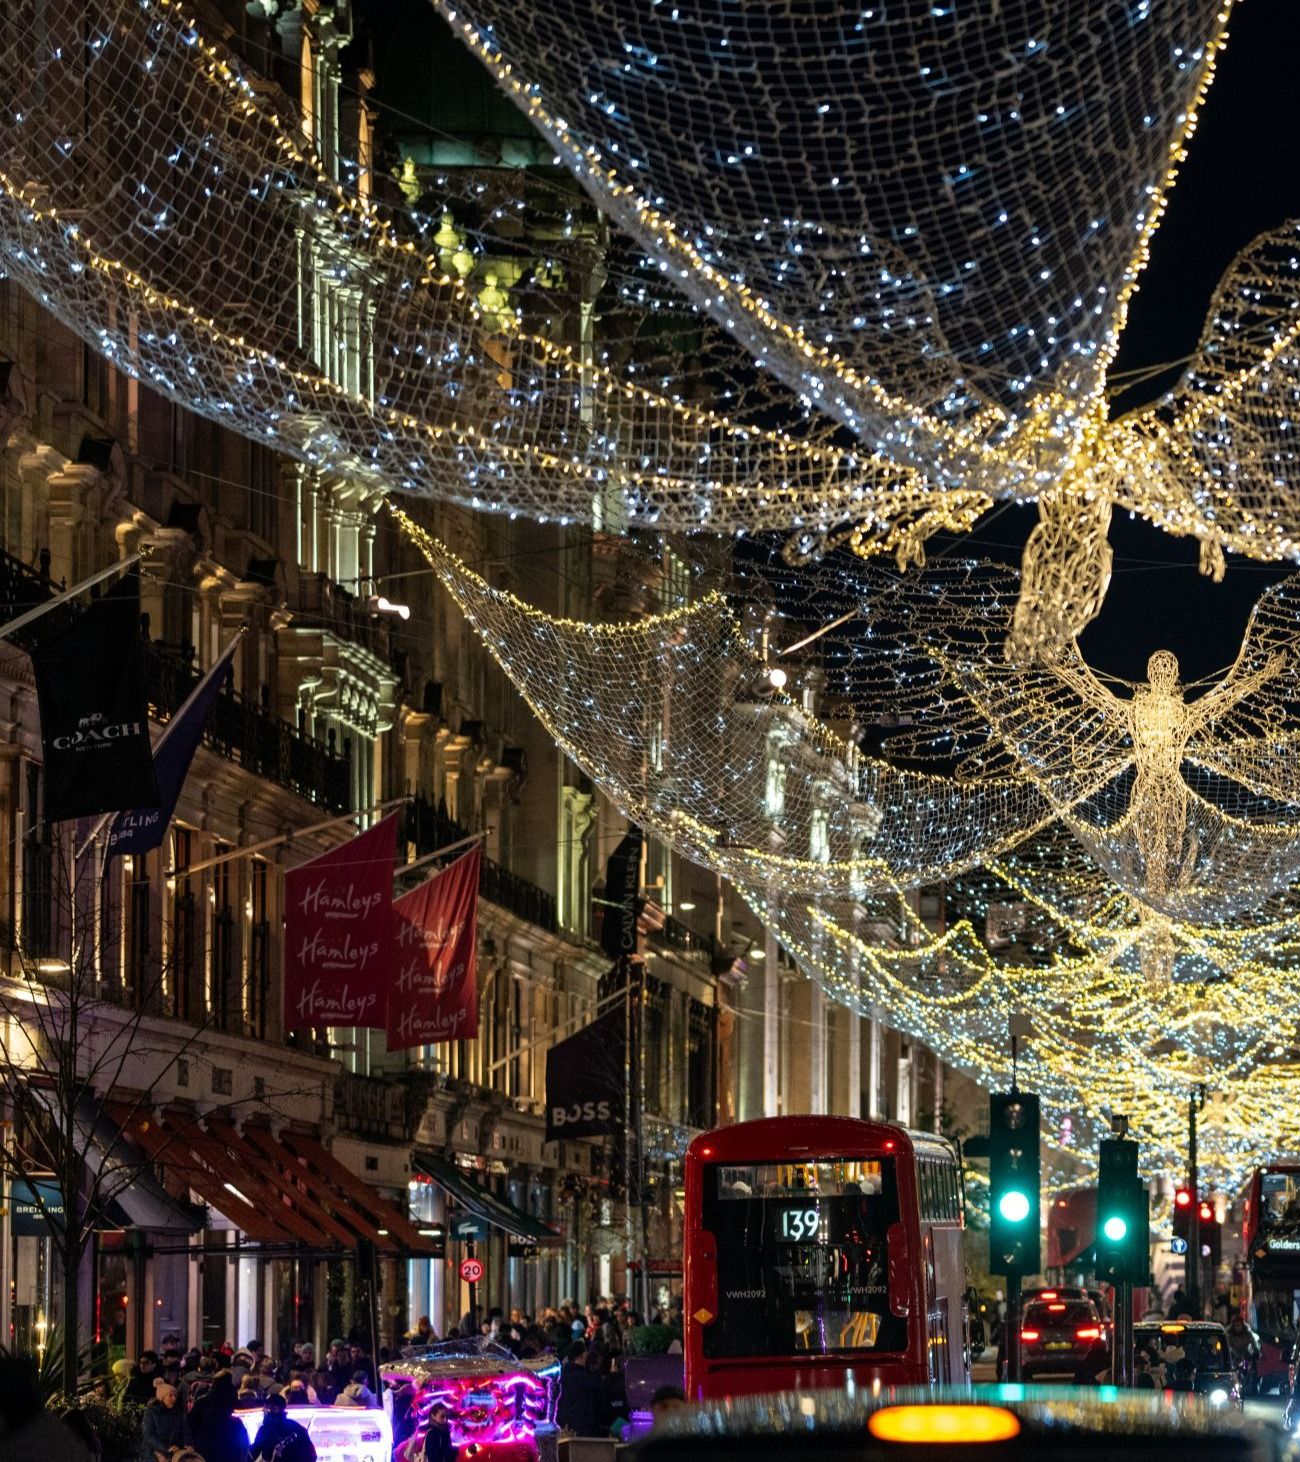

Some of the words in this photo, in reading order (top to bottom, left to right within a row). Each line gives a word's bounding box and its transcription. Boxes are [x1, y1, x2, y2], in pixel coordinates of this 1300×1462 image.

[53, 723, 141, 750] COACH
[625, 846, 640, 889] KLEIN
[298, 878, 381, 919] Hamleys
[396, 917, 466, 949] Hamleys
[620, 892, 635, 949] CALVIN
[296, 928, 379, 970] Hamleys
[395, 957, 465, 993] Hamleys
[295, 978, 377, 1021] Hamleys
[398, 1003, 467, 1039] Hamleys
[552, 1100, 610, 1126] BOSS
[782, 1210, 819, 1241] 139
[1269, 1240, 1300, 1249] Golders
[464, 1265, 481, 1276] 20
[726, 1289, 767, 1299] VWH2092
